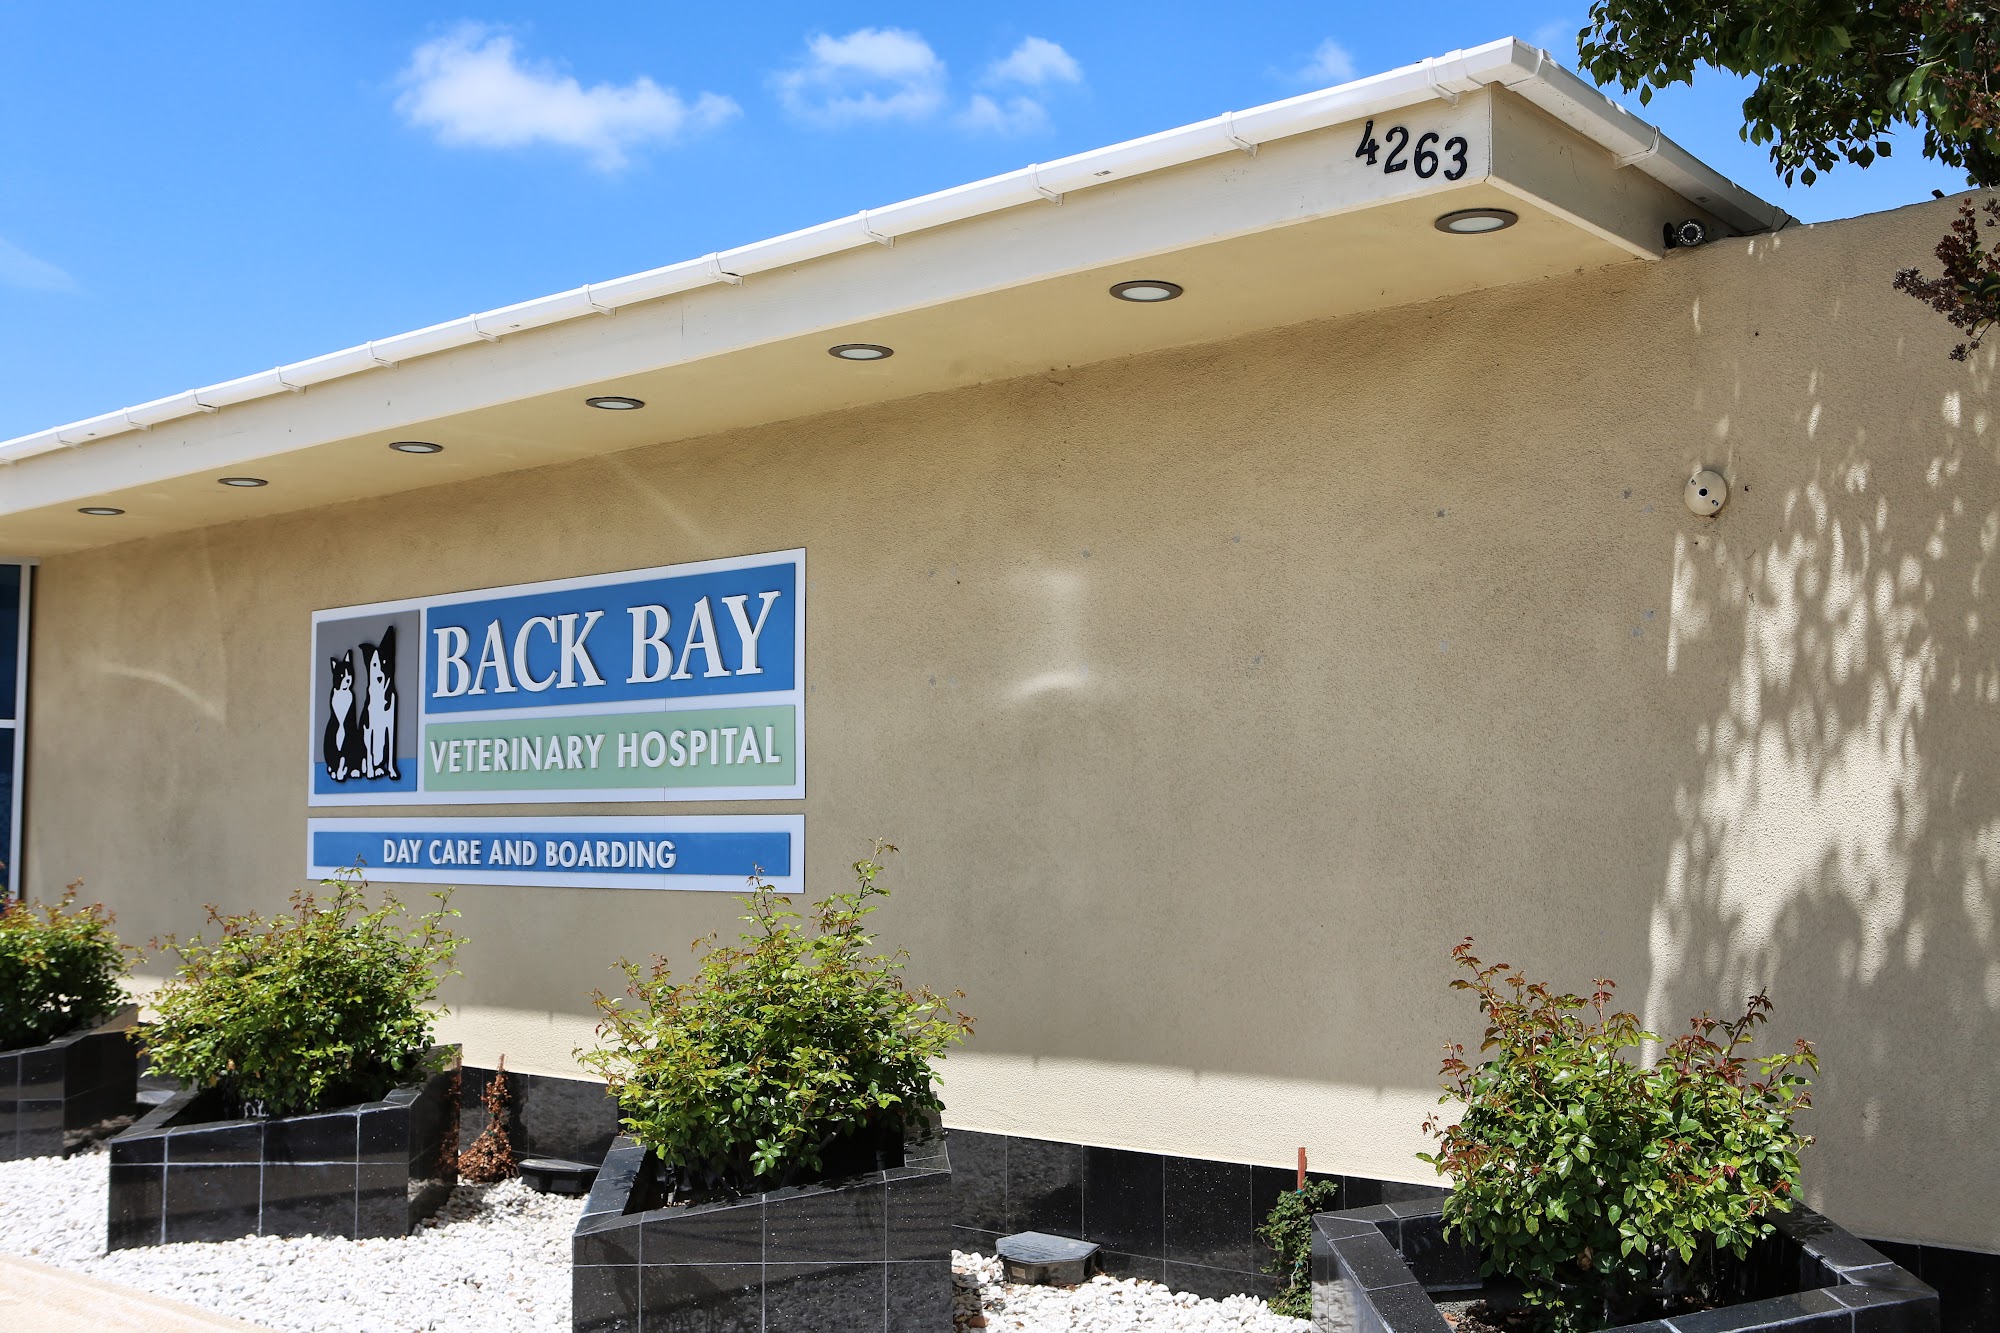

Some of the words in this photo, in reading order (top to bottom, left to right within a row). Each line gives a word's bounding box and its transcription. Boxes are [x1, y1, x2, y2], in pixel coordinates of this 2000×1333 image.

[1355, 121, 1468, 180] 4263
[432, 610, 606, 698] BACK
[626, 590, 782, 684] BAY
[429, 734, 606, 773] VETERINARY
[617, 726, 783, 768] HOSPITAL
[382, 839, 423, 864] DAY
[428, 839, 482, 866] CARE
[487, 839, 538, 867] AND
[545, 840, 677, 869] BOARDING
